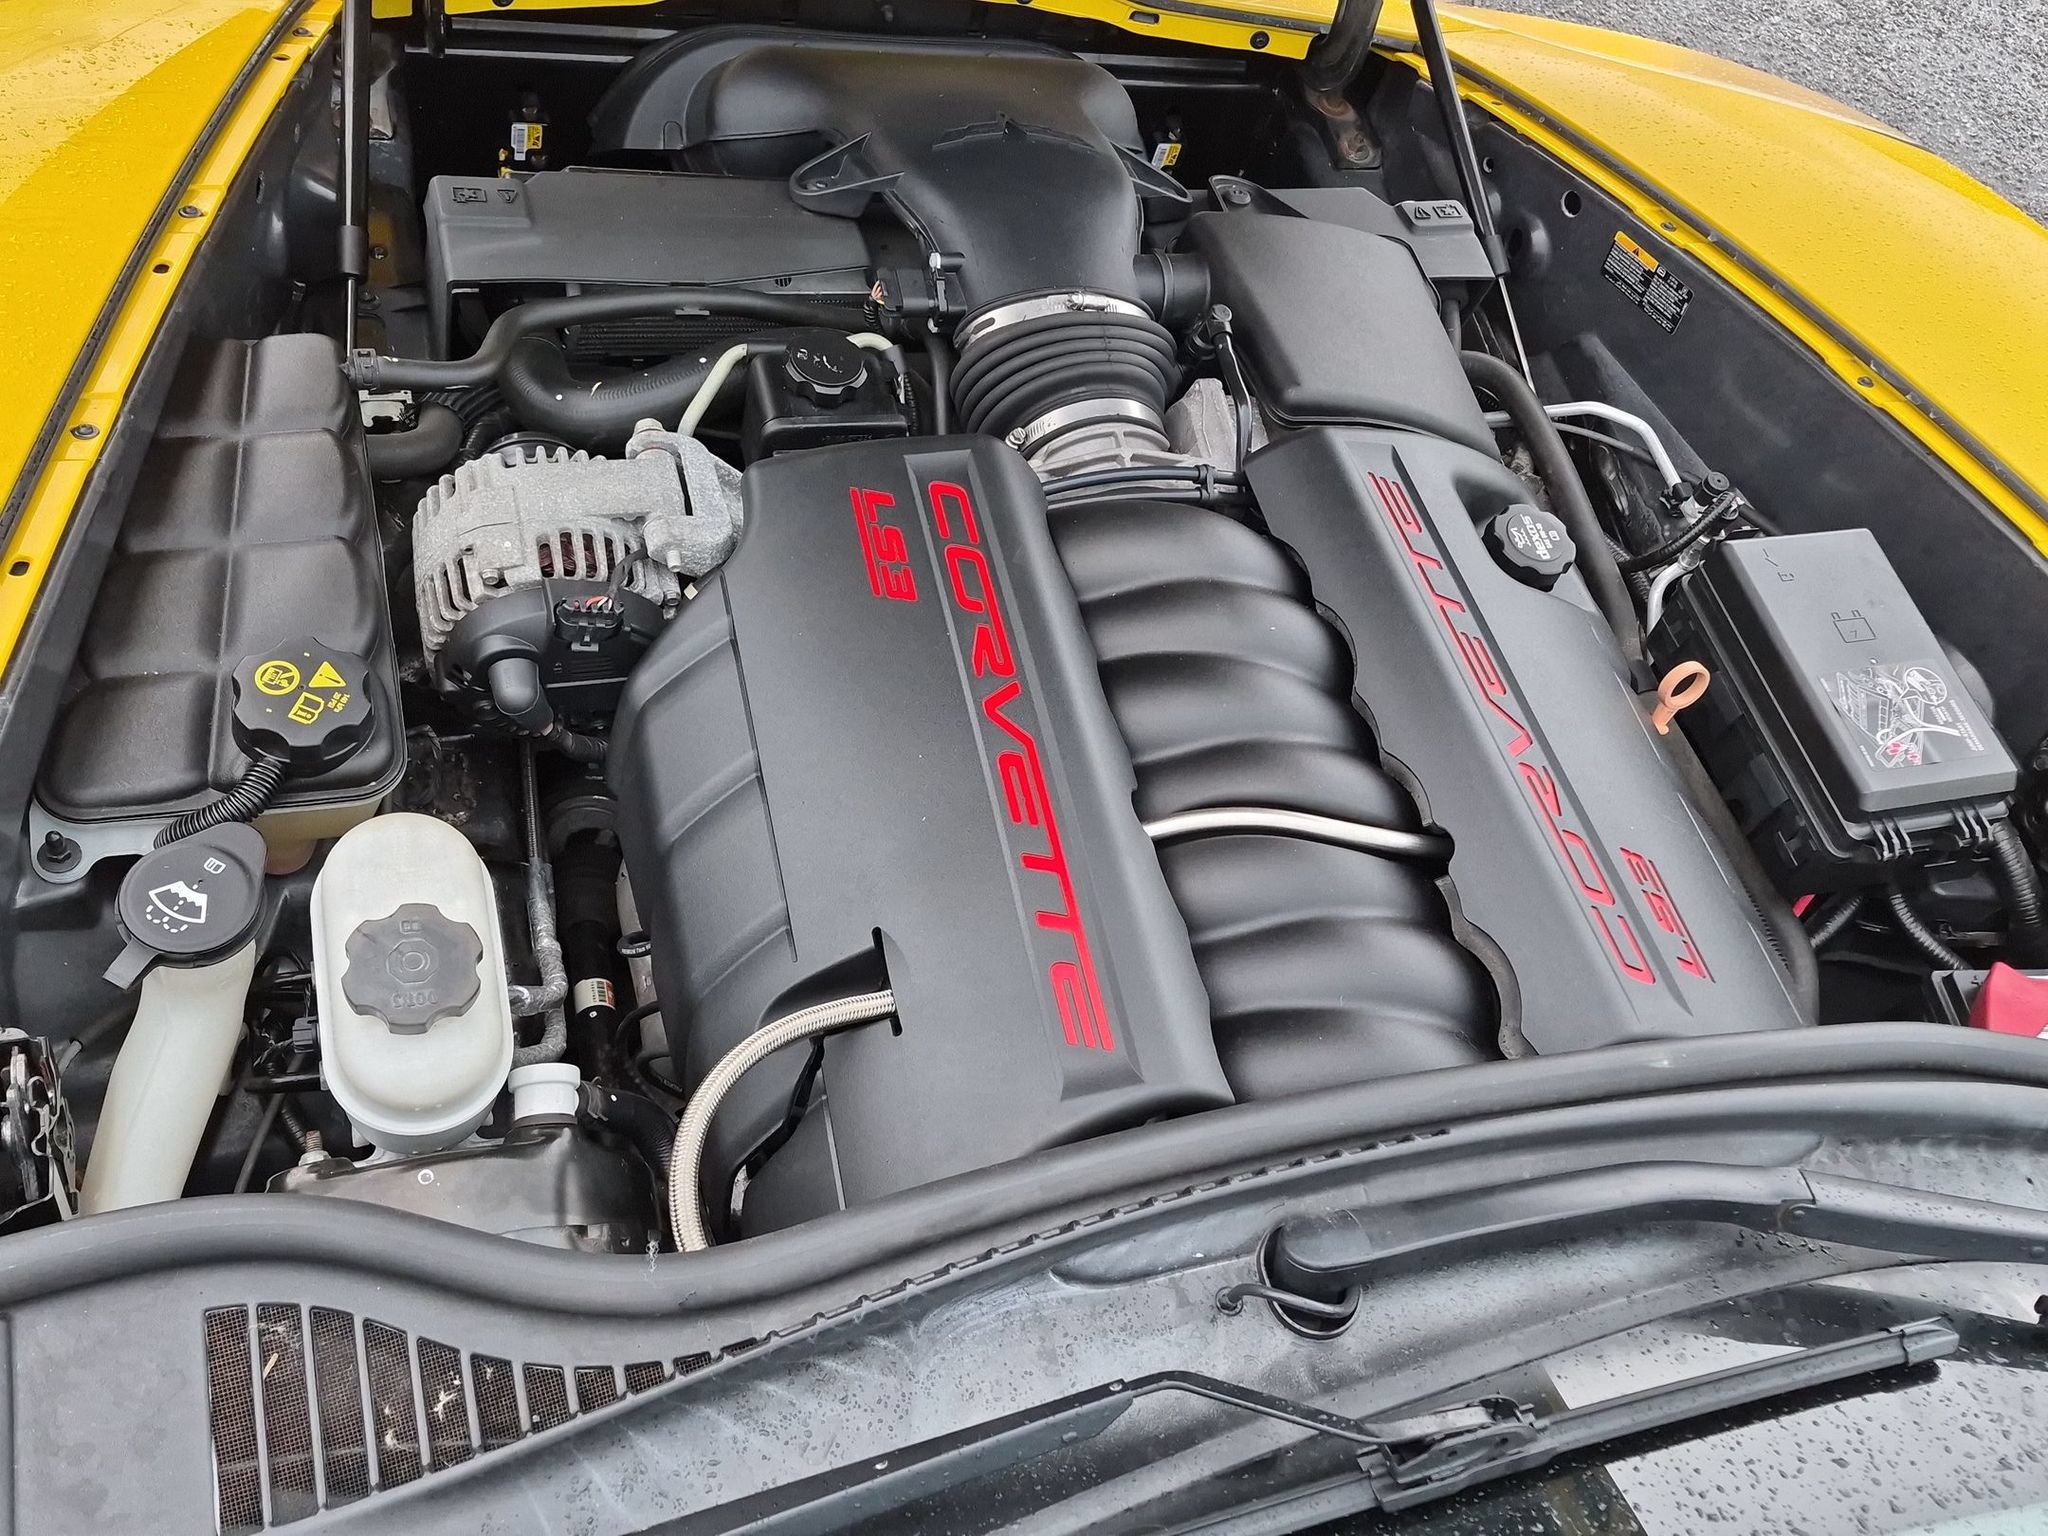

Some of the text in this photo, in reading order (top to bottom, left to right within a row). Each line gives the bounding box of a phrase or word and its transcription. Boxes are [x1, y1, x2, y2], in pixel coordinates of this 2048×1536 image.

[850, 487, 918, 602] LS3
[1520, 514, 1550, 559] dexos
[928, 480, 1115, 1051] CORVETTE
[1368, 472, 1656, 985] CORVETTE
[1619, 847, 1716, 984] LS3
